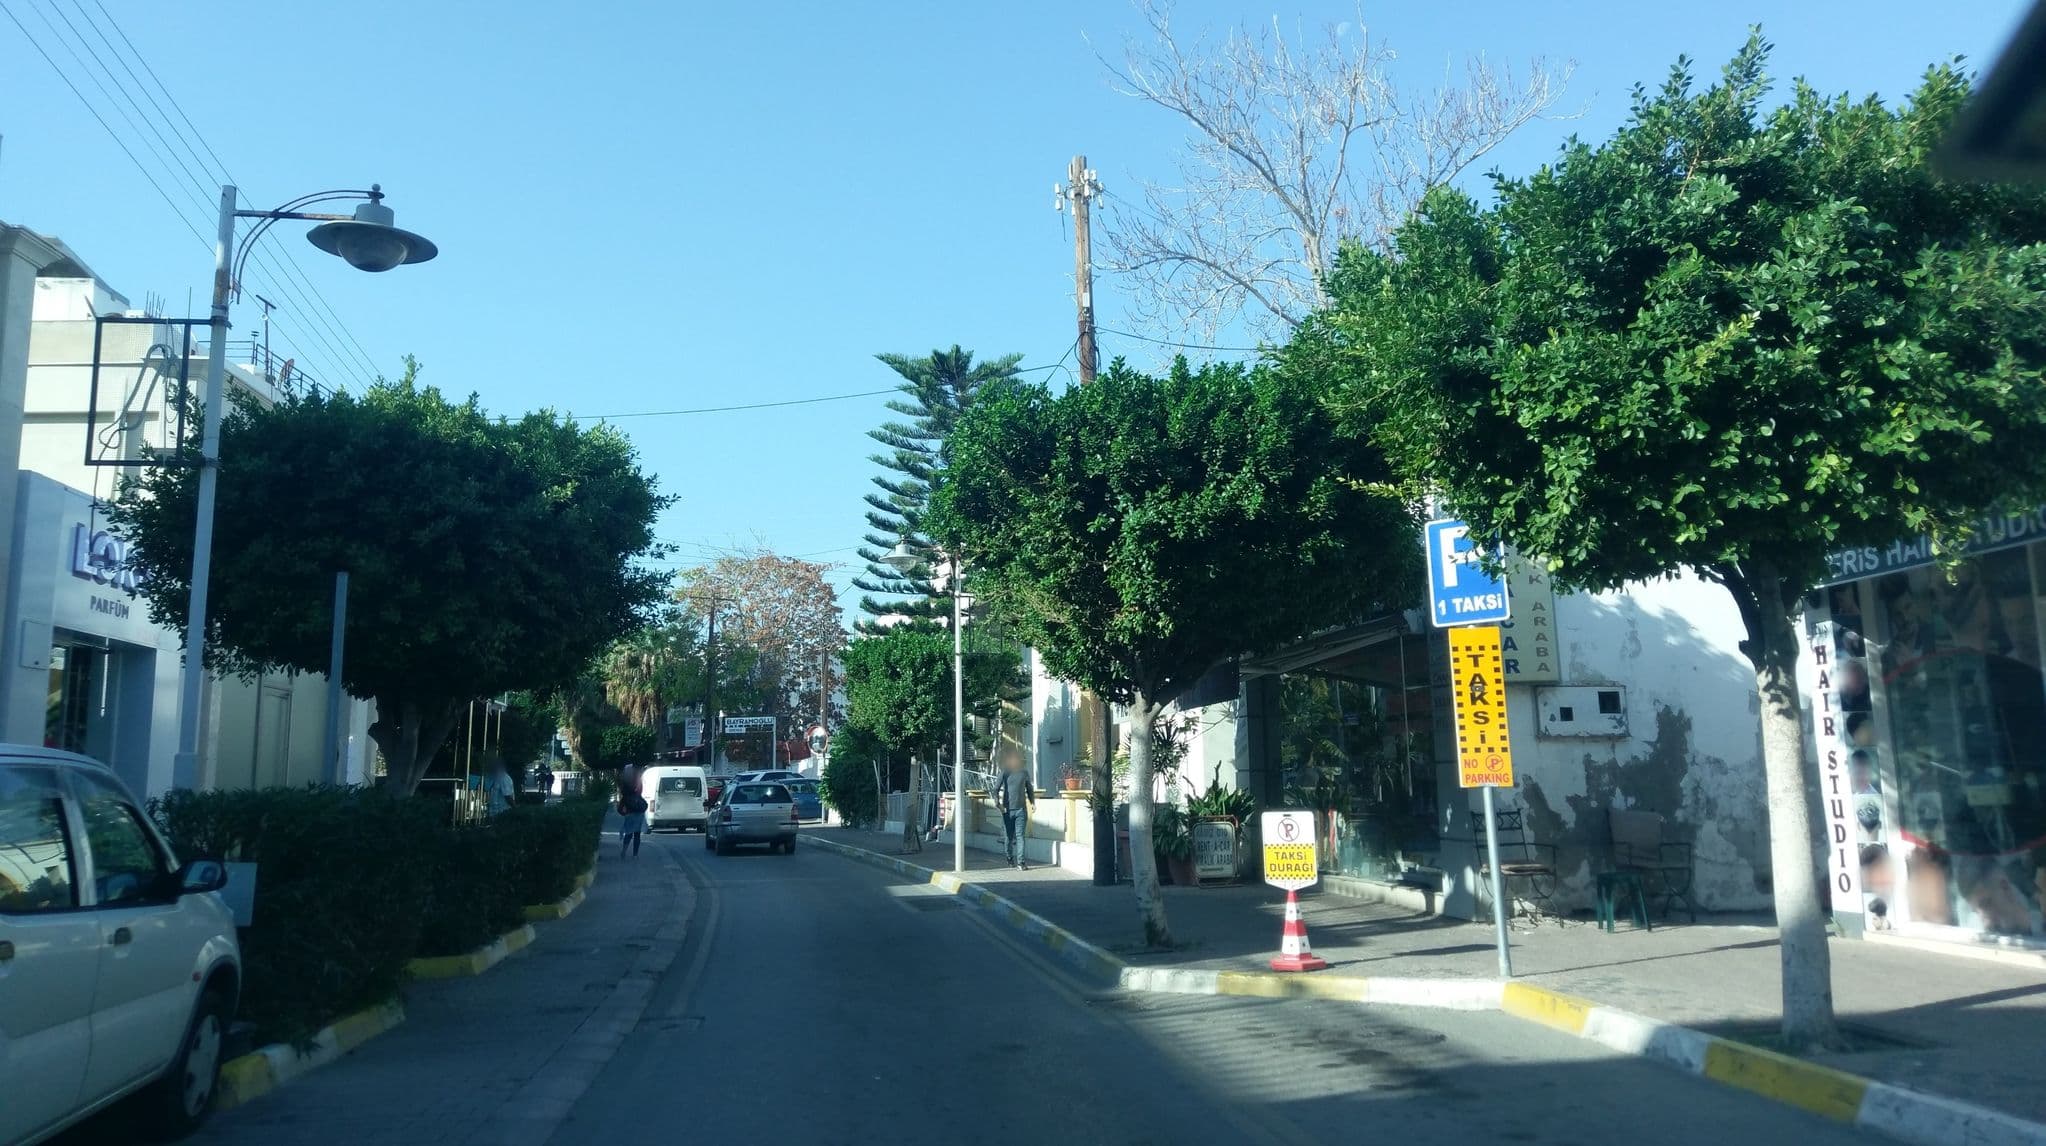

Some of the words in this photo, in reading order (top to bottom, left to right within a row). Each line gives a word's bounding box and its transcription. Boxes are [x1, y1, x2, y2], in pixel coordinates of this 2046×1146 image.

[1438, 600, 1447, 616] 1
[1532, 602, 1550, 672] ARABA
[1464, 758, 1478, 768] NO
[1814, 645, 1835, 736] HAIR
[1827, 750, 1851, 893] STUDIO
